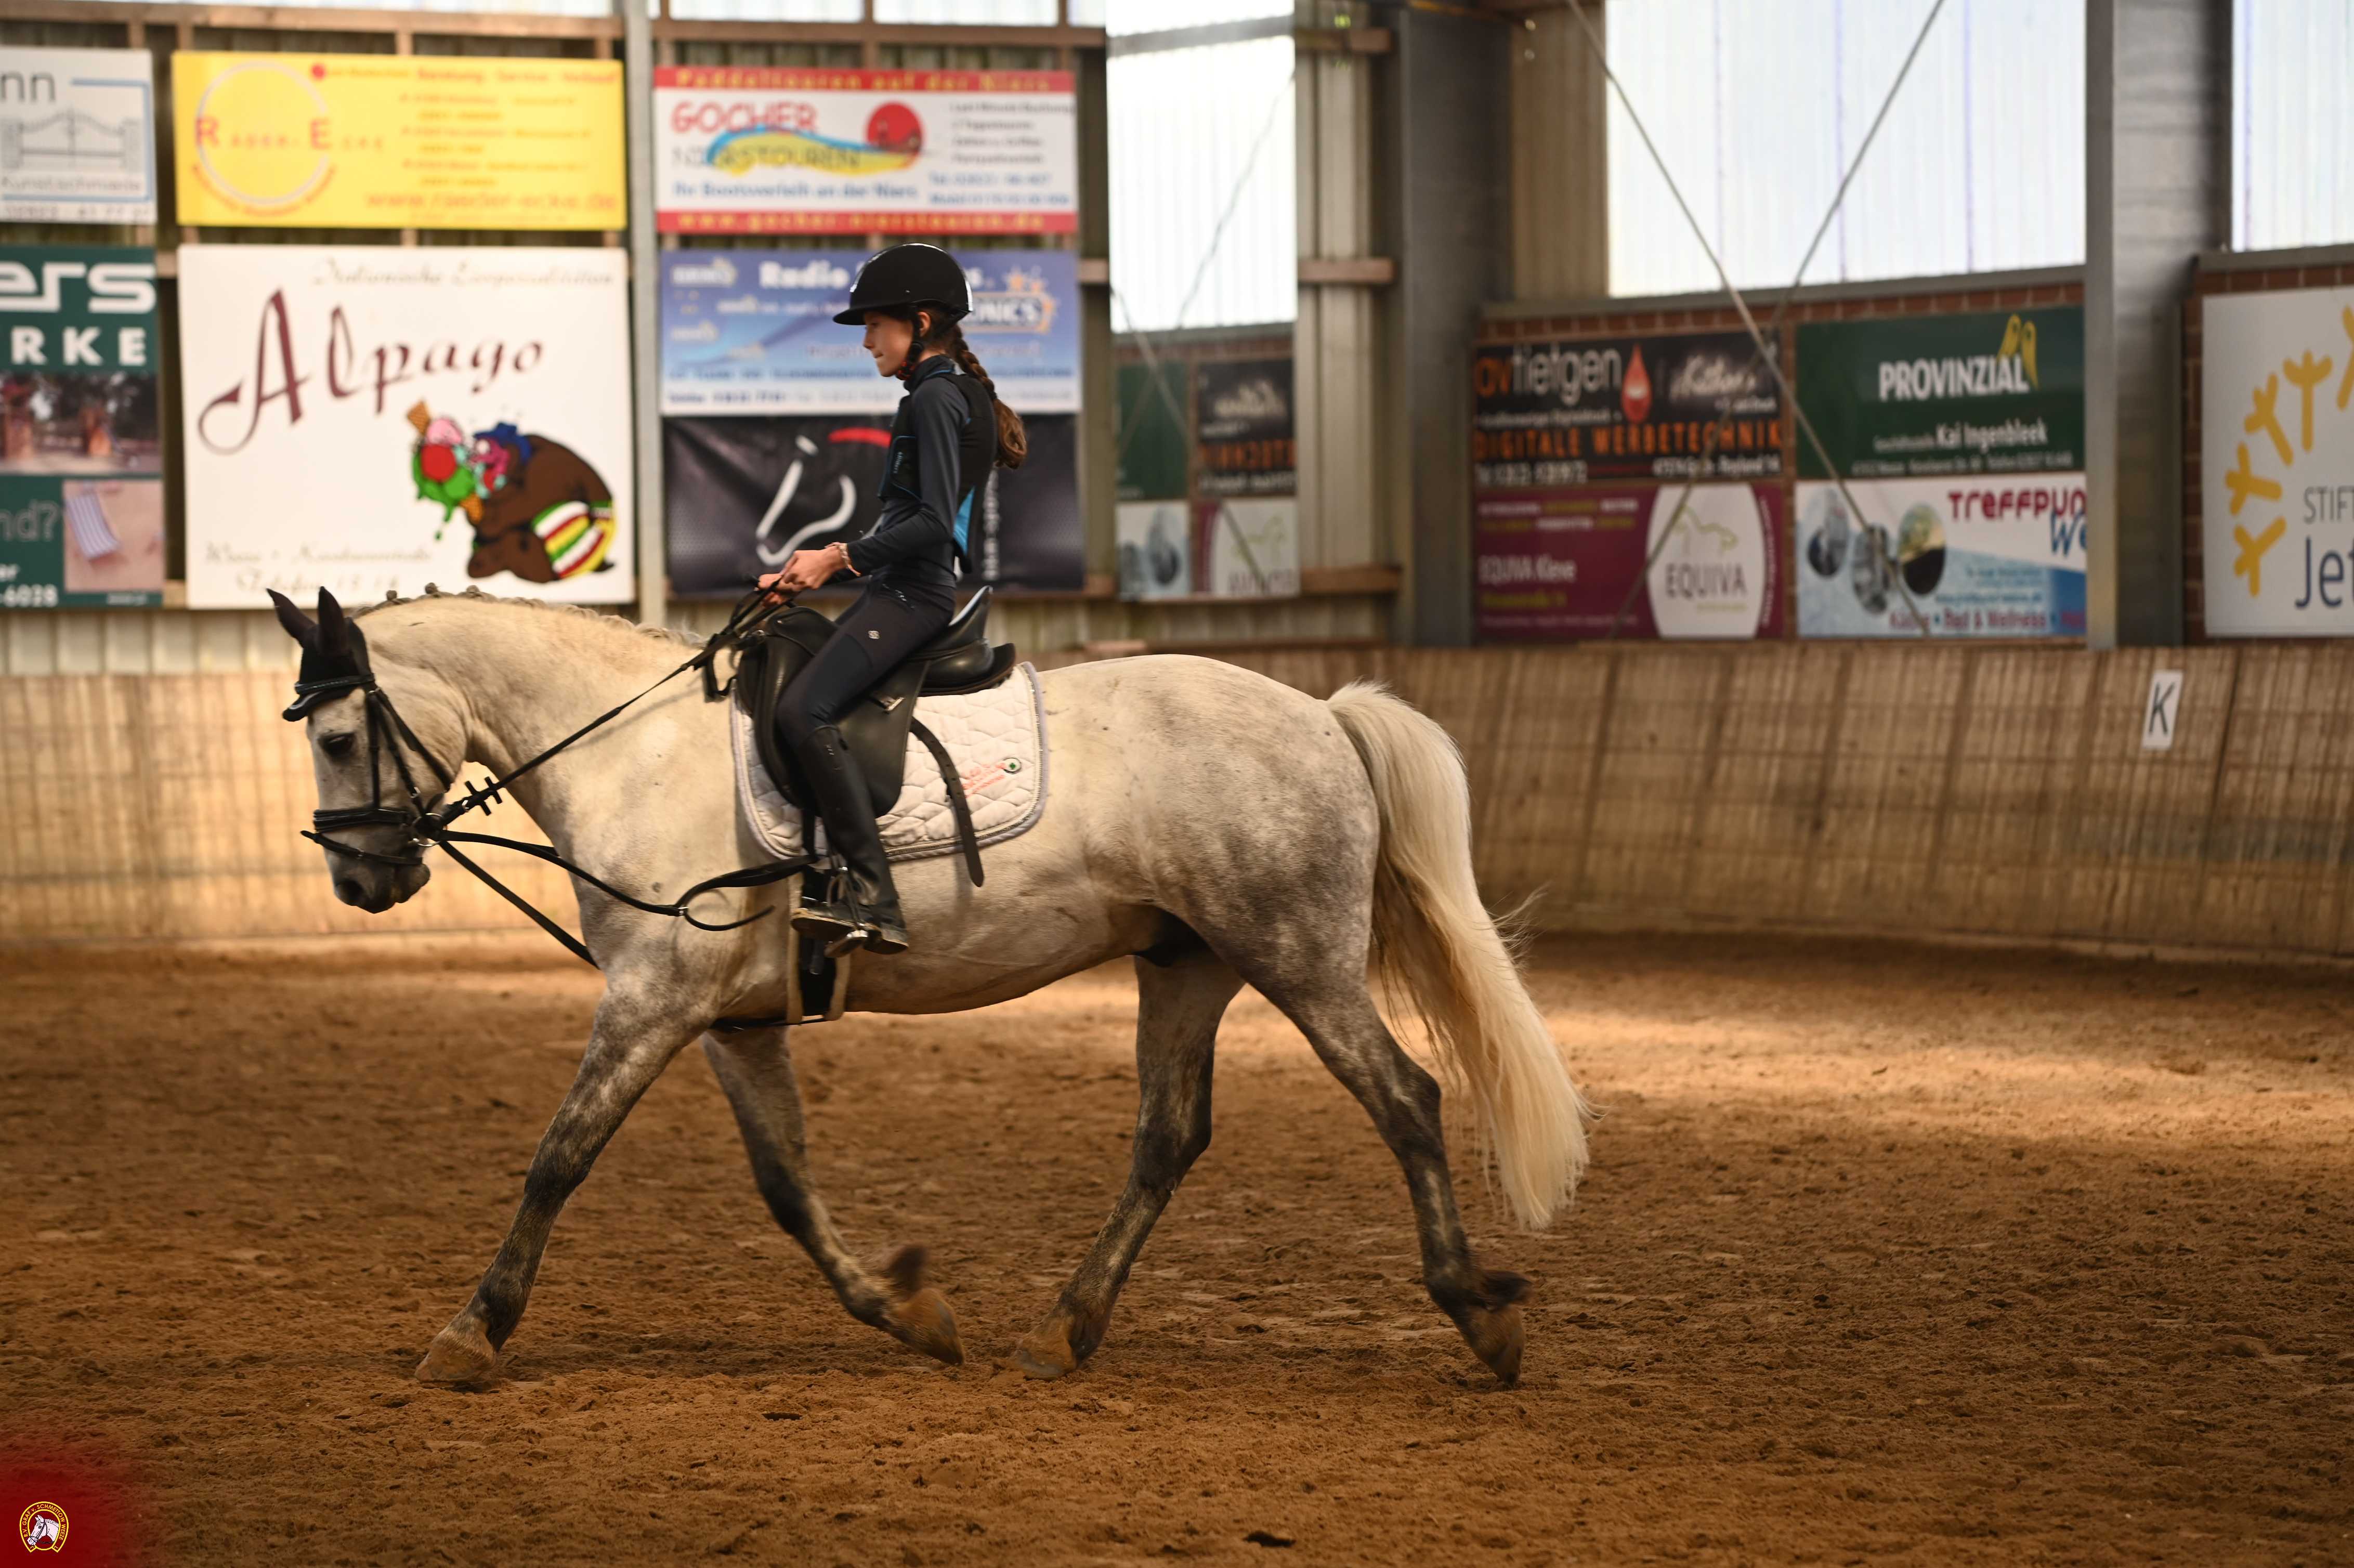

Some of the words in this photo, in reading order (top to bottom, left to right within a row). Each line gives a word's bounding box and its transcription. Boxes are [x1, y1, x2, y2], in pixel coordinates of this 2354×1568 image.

[677, 69, 861, 90] Paddeltouren
[871, 71, 916, 91] auf
[926, 73, 969, 92] der
[979, 73, 1050, 92] Niers
[671, 101, 817, 134] GOCHER
[759, 259, 851, 289] Radio
[198, 288, 544, 455] Alpago
[1879, 354, 2030, 402] PROVINZIAL
[1474, 426, 1581, 461] DIGITALE
[1593, 419, 1782, 456] WERBETECHNIK
[1935, 420, 1961, 450] Kai
[1477, 558, 1534, 586] EQUIVA
[1536, 552, 1577, 584] Kleve
[1665, 562, 1748, 601] EQUIVA
[2148, 681, 2176, 736] K
